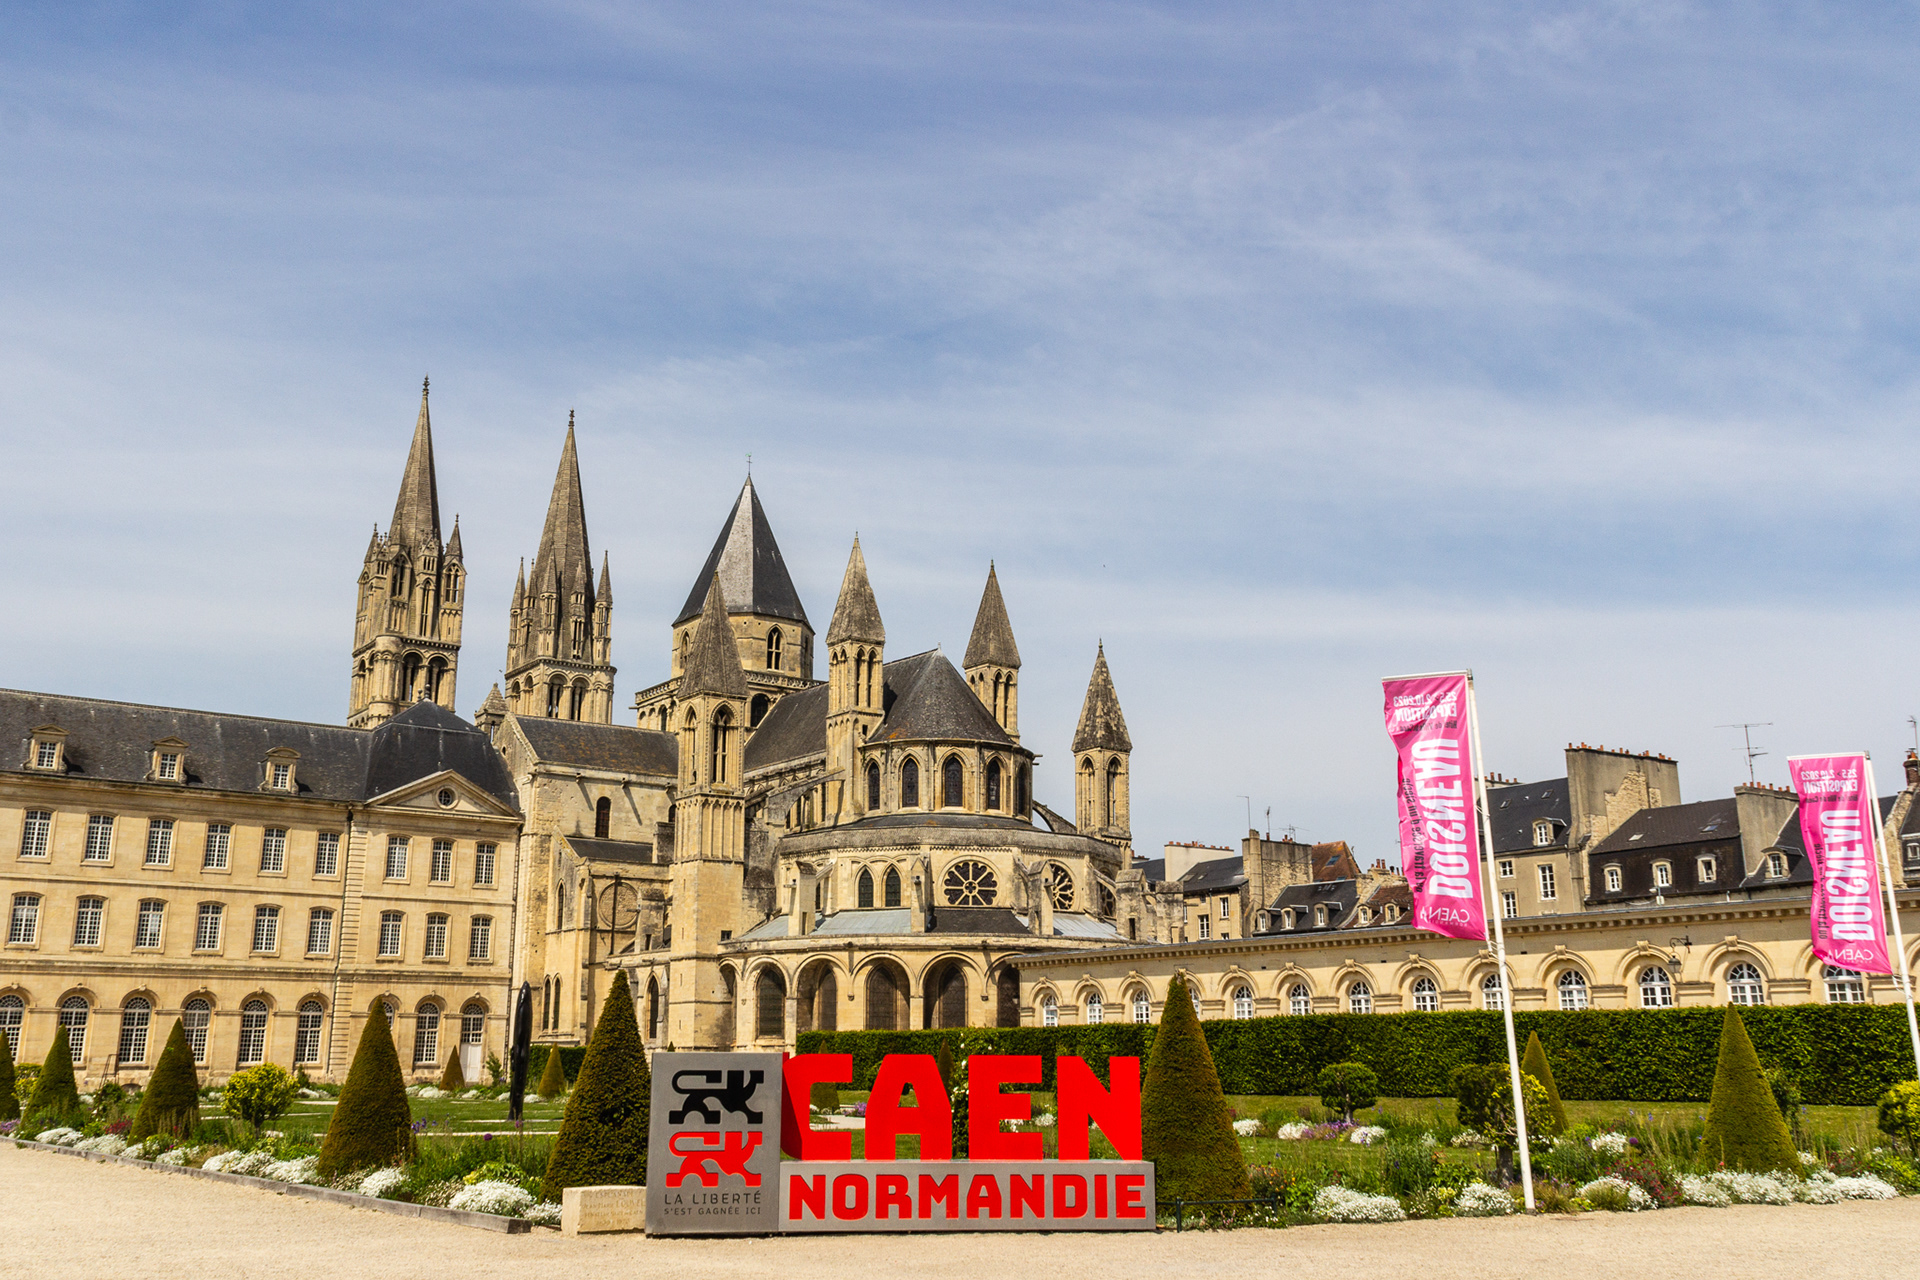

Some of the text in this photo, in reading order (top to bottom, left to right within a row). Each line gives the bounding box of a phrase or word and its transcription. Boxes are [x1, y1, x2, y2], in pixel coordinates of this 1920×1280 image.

[781, 1052, 1143, 1161] CAEN
[664, 1190, 761, 1205] LA LIBERTÉ
[664, 1206, 761, 1216] S'EST GAGNÉE ICI
[788, 1173, 1147, 1220] NORMANDIE
